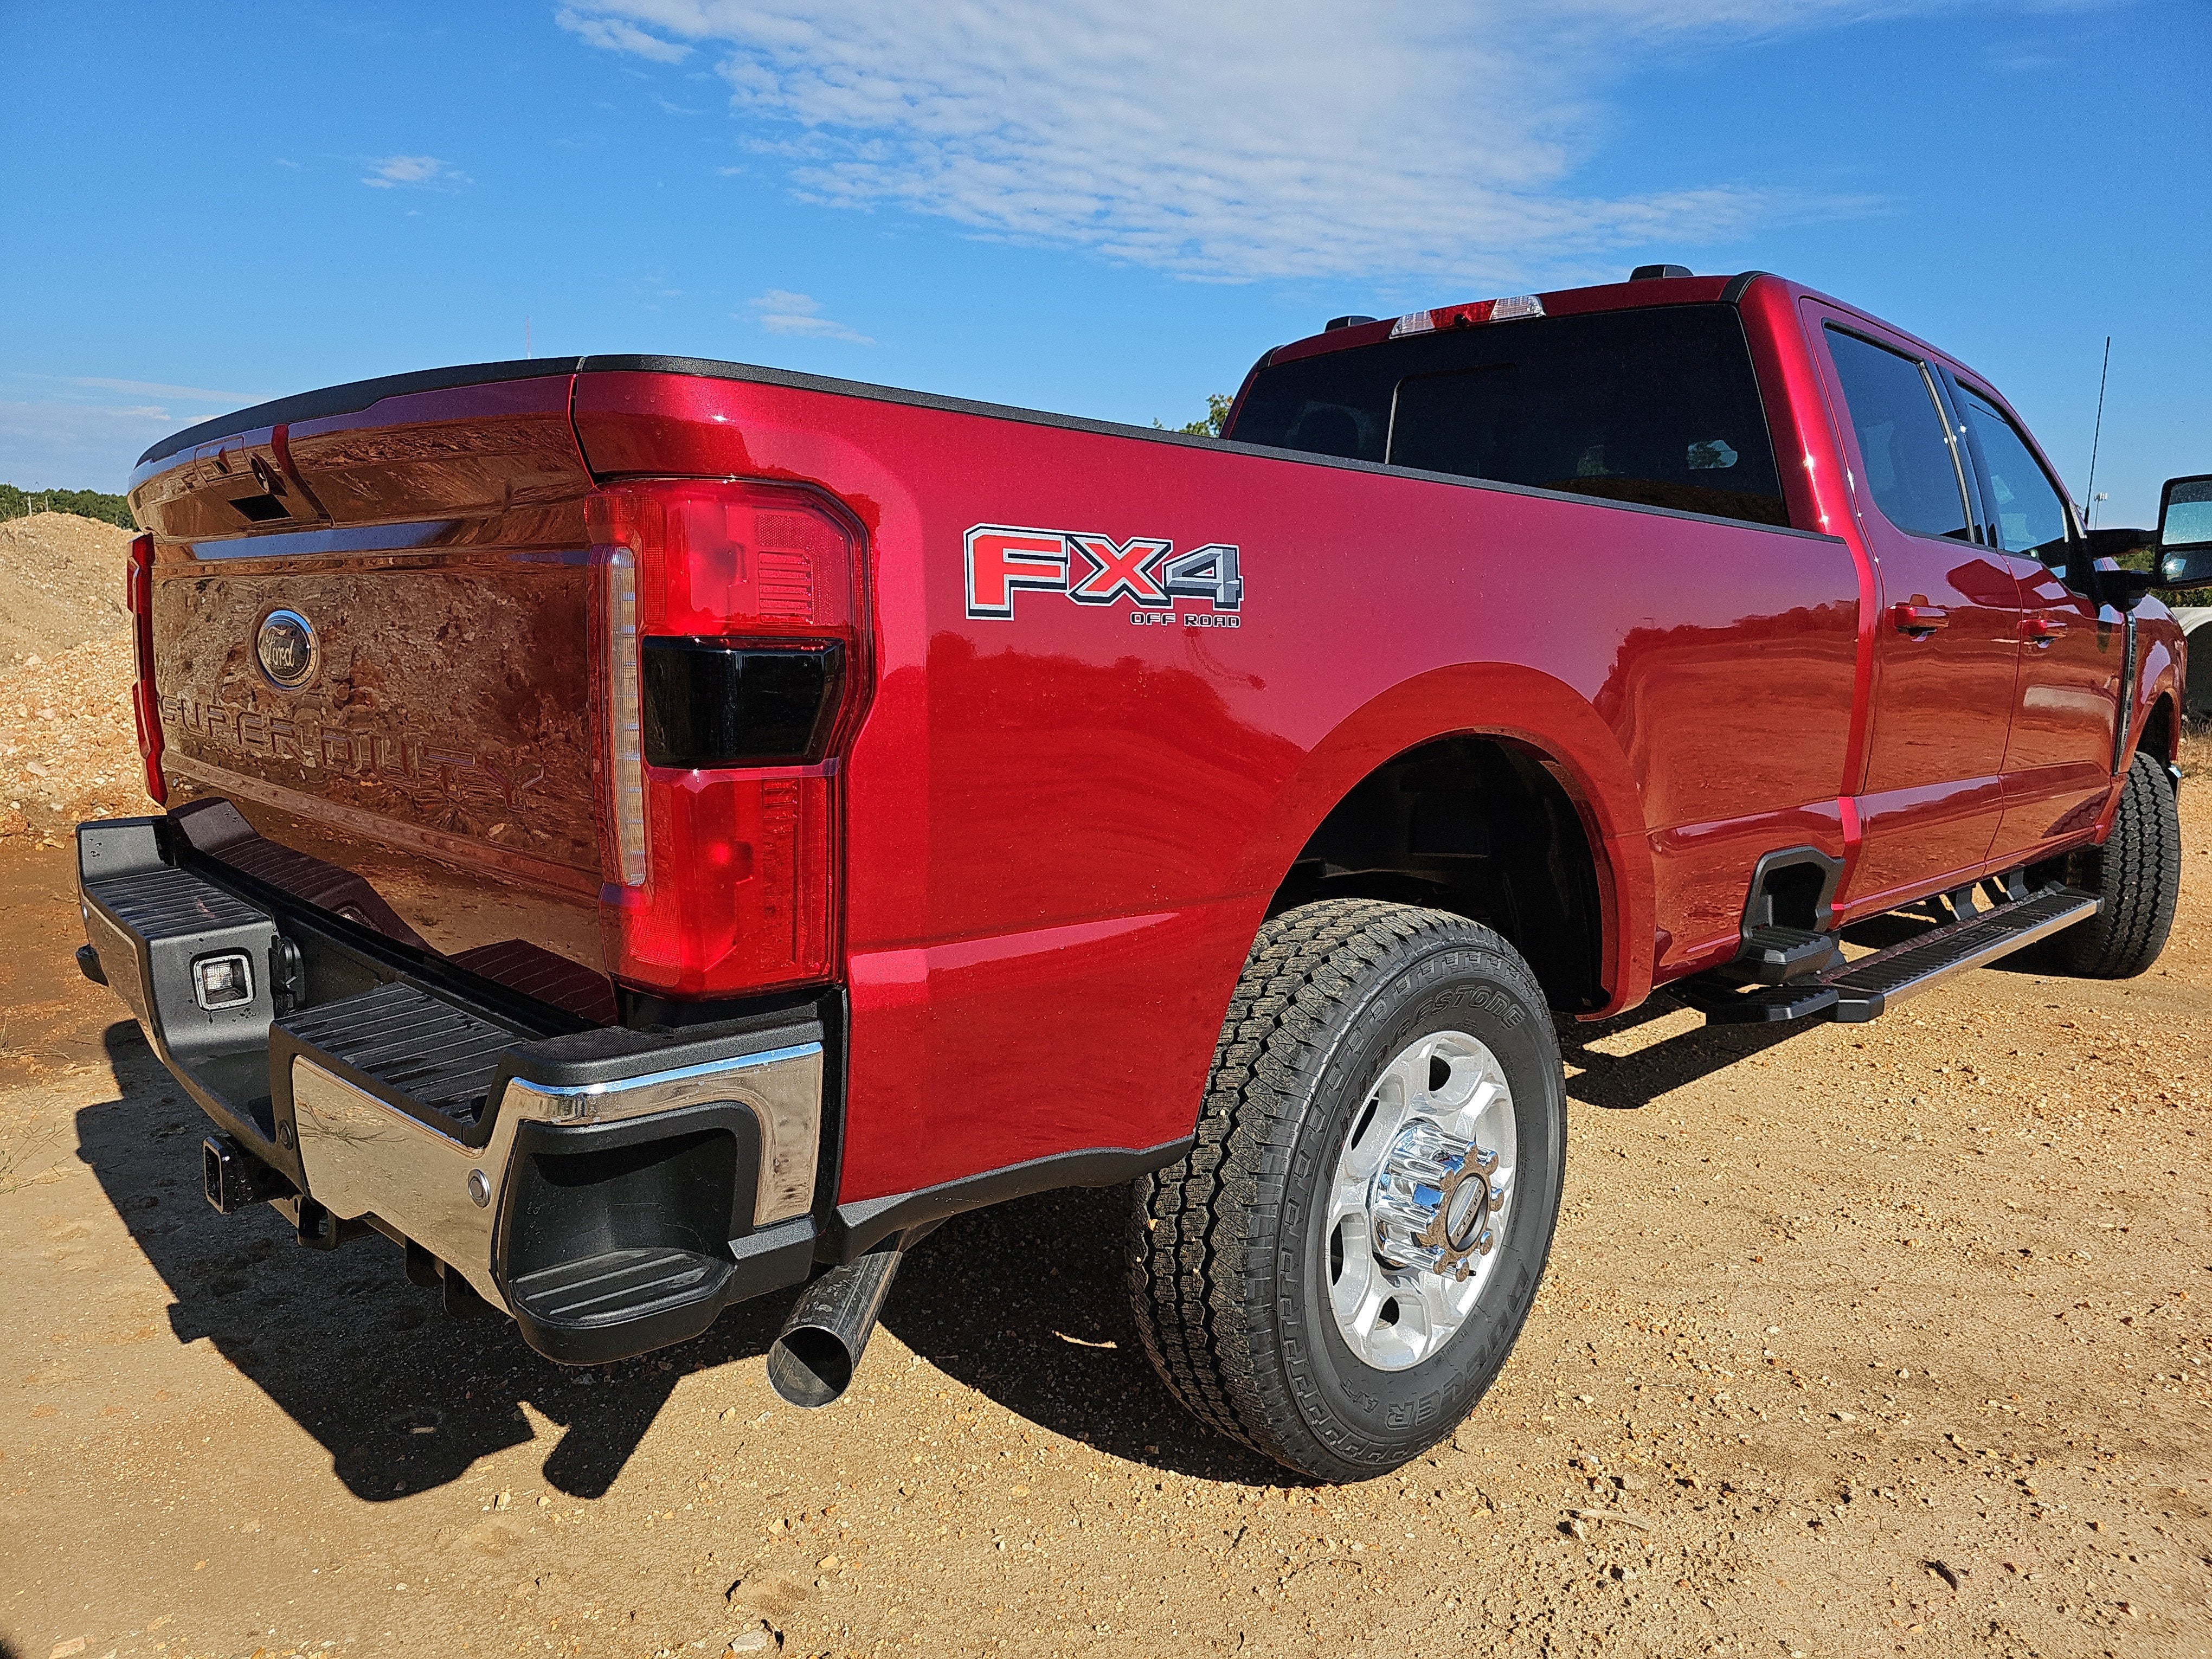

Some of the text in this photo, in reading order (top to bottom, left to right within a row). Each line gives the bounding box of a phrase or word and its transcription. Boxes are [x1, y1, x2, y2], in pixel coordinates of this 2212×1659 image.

[963, 523, 1244, 620] FX4
[262, 626, 295, 667] Ford
[1130, 612, 1241, 628] OFF ROAD
[161, 695, 545, 813] SUPER DUTY
